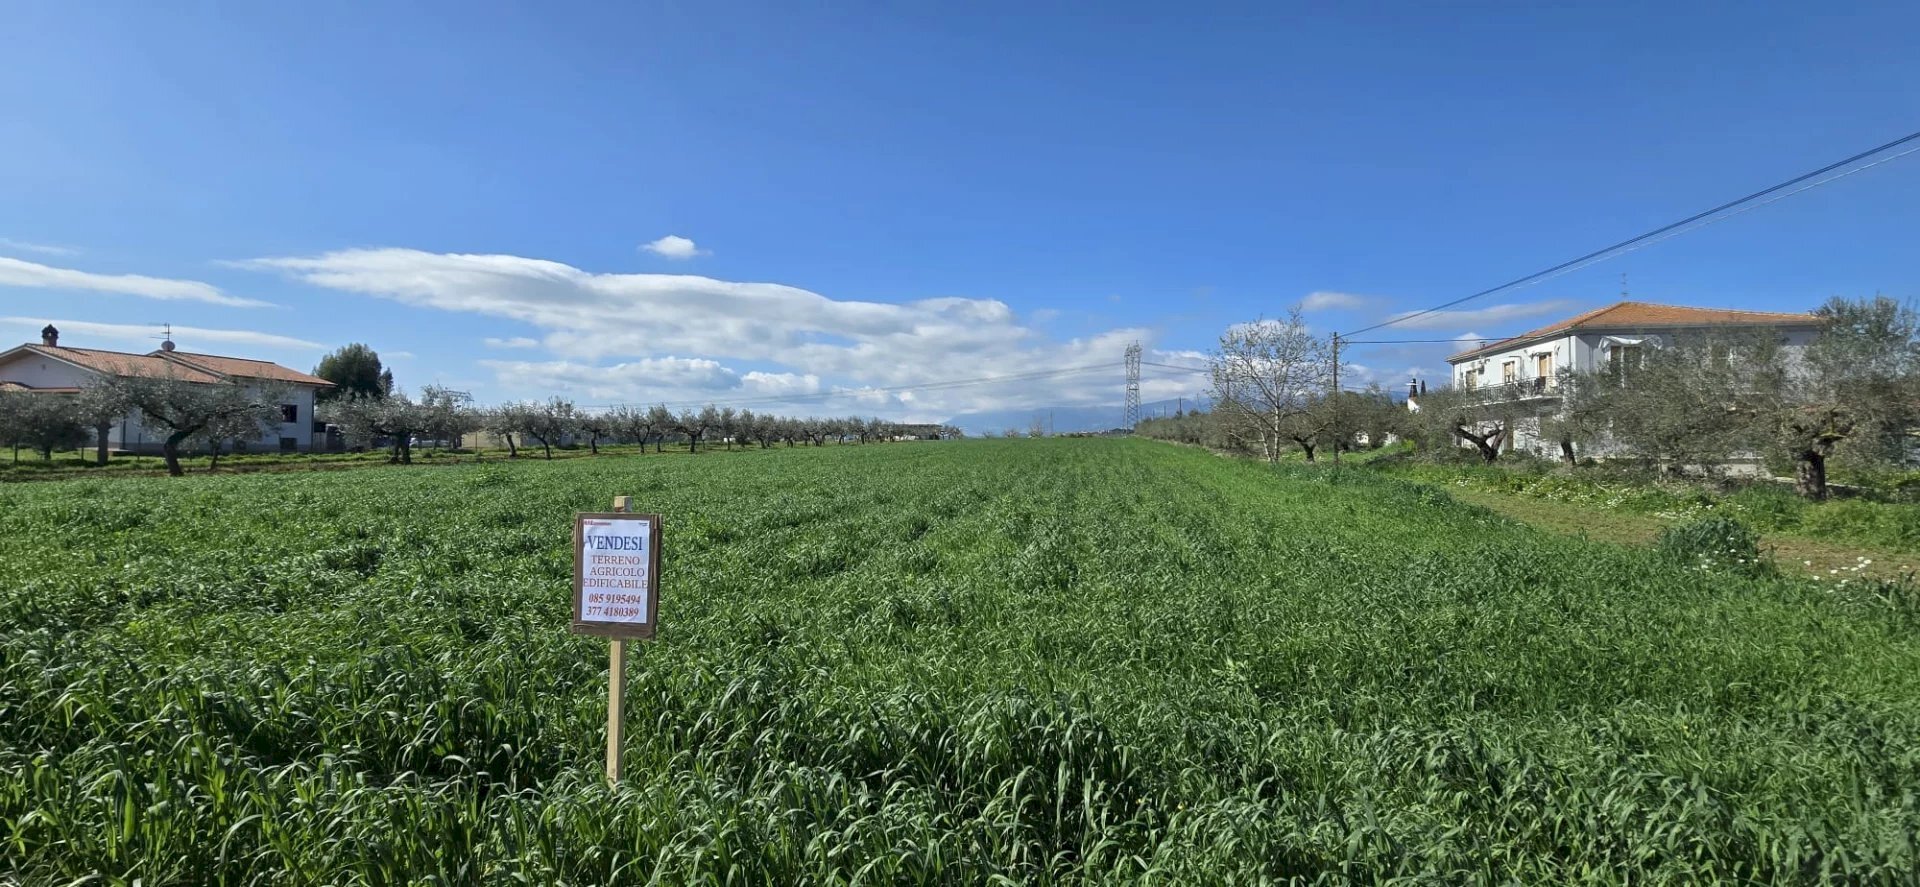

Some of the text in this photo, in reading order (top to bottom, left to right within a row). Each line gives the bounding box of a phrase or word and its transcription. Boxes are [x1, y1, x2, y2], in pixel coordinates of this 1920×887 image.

[587, 535, 643, 551] VENDESI
[591, 555, 640, 565] TERRENO
[589, 567, 645, 577] AGRICOLO
[583, 578, 648, 589] EDIFICABILE
[588, 593, 641, 604] 085 9195494
[586, 606, 639, 617] 377 4180389
